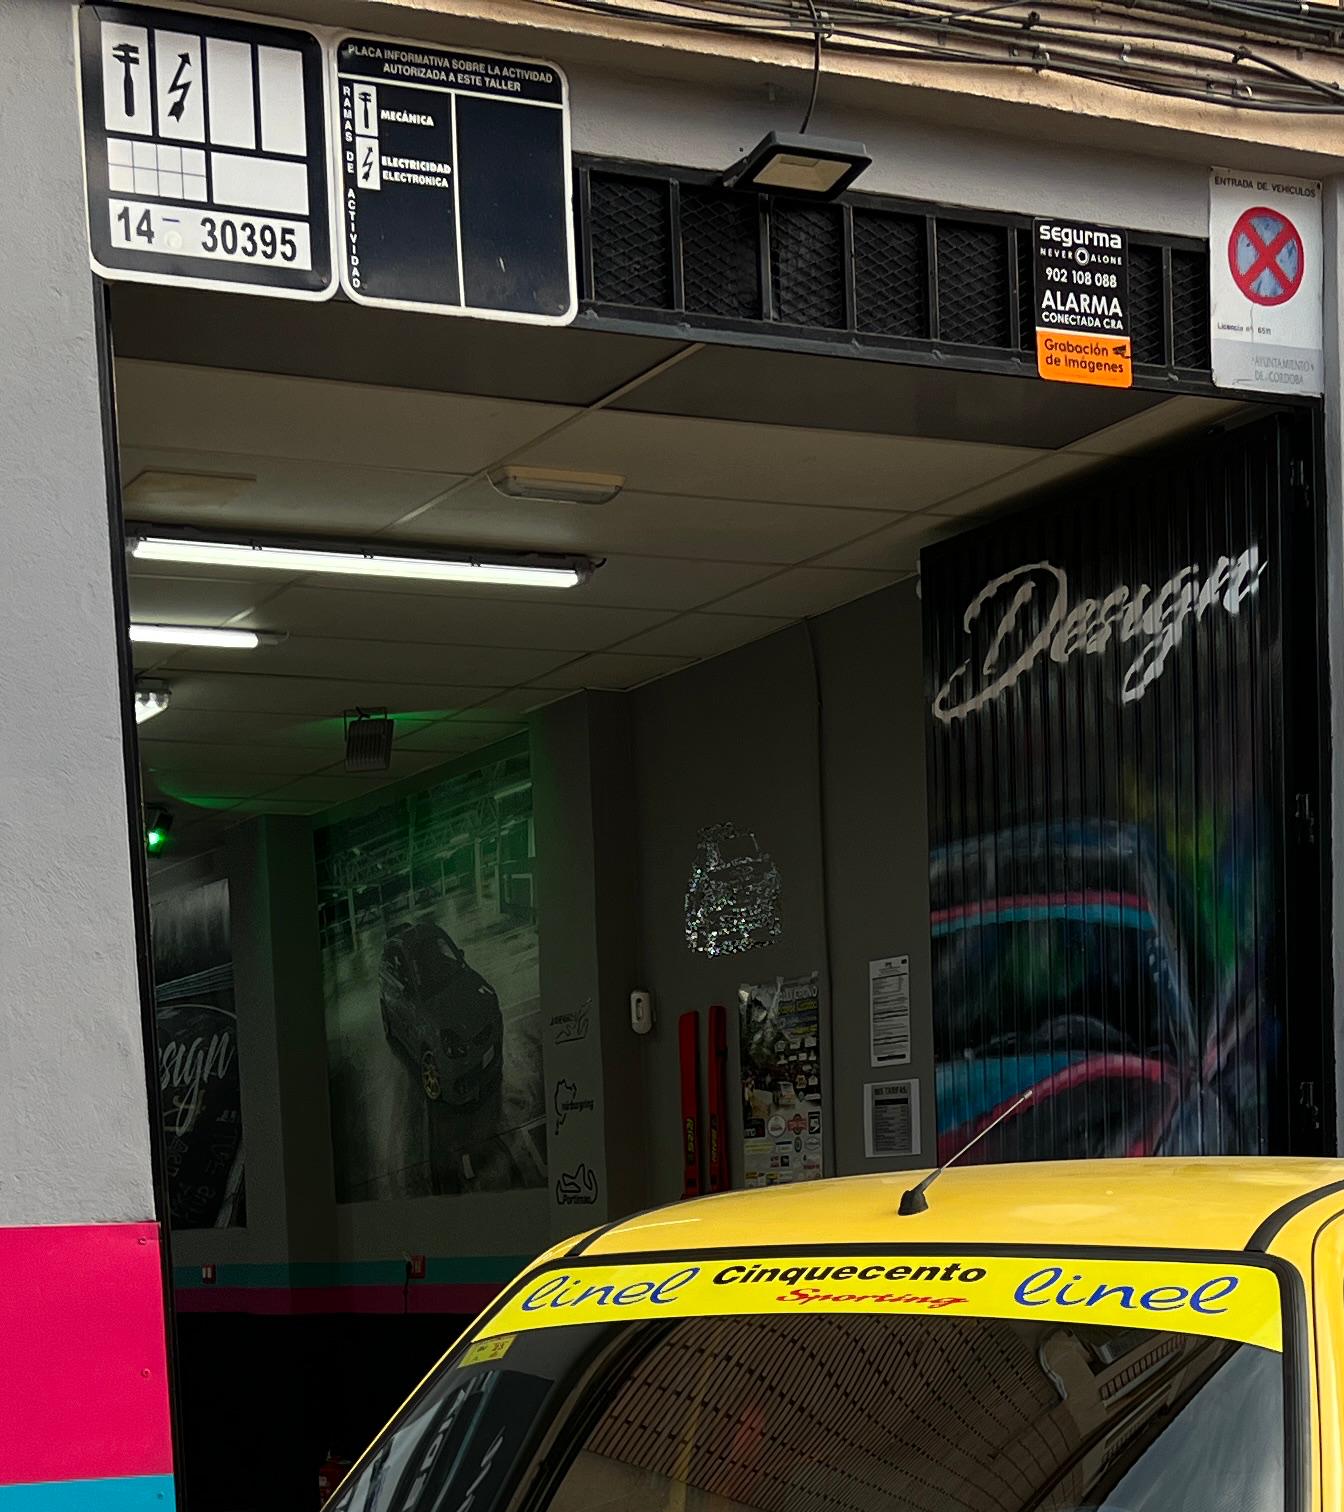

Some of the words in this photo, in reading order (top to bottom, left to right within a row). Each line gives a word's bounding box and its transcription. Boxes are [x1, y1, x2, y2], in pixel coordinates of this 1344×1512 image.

[348, 44, 382, 60] PLACA
[384, 49, 450, 69] INFORMATIVA
[452, 60, 486, 74] SOBRE
[487, 64, 501, 76] LA
[502, 66, 553, 84] ACTIVIDAD
[383, 63, 446, 82] AUTORIZADA
[448, 73, 456, 83] A
[457, 75, 483, 87] ESTE
[484, 77, 522, 92] TALLER
[342, 86, 354, 143] RAMAS
[380, 109, 435, 127] MECÁNICA
[381, 155, 452, 174] ELECTRICIDAD
[382, 170, 449, 188] ELECTRONICA
[1214, 175, 1254, 190] ENTRADA
[1256, 181, 1269, 191] DE
[117, 206, 155, 244] 14
[200, 216, 298, 262] 30395
[347, 188, 362, 288] ACTIVIDAD
[1039, 224, 1122, 249] segurma
[1040, 247, 1073, 260] NEVER
[1090, 253, 1123, 266] ALONE
[1045, 267, 1068, 283] 902
[1072, 269, 1092, 286] 108
[1094, 271, 1118, 288] 088
[1041, 289, 1123, 317] ALARMA
[1041, 311, 1101, 328] CONECTADA
[1102, 318, 1124, 331] CRA
[1044, 338, 1109, 358] Grabación
[1045, 353, 1061, 367] de
[932, 546, 1268, 723] Design
[712, 1262, 988, 1286] Cinquecento
[520, 1267, 701, 1312] linel
[776, 1288, 972, 1309] Sporting
[1014, 1266, 1240, 1315] linel
